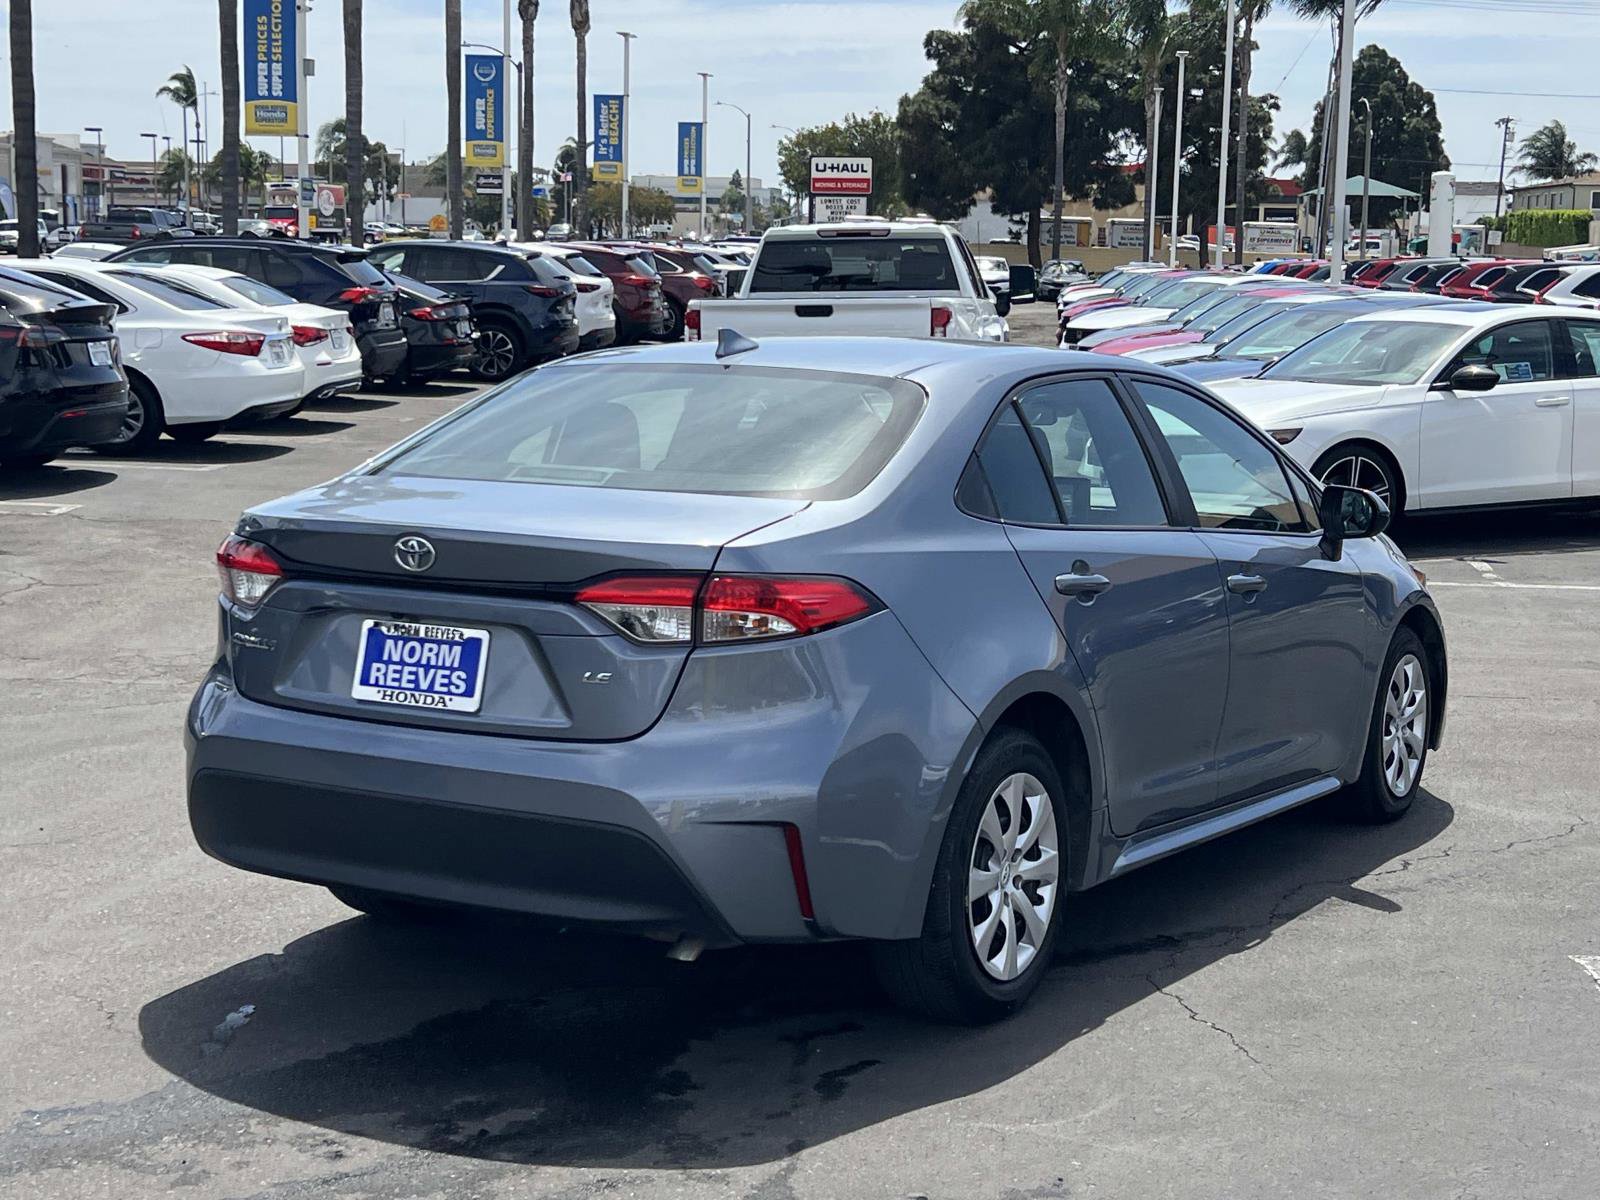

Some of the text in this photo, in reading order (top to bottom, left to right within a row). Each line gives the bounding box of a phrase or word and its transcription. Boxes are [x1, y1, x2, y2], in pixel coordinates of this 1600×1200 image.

[256, 15, 269, 97] SUPER PRICES
[271, 62, 283, 97] SUPER
[475, 97, 486, 130] SUPER
[486, 88, 495, 138] EXPERIENCE
[598, 102, 608, 155] It's Better
[608, 99, 620, 145] BEACH!
[815, 163, 868, 173] U-HAUL
[382, 639, 463, 668] NORM
[368, 662, 468, 694] REEVES
[582, 671, 613, 684] LE
[380, 689, 449, 707] HONDA
